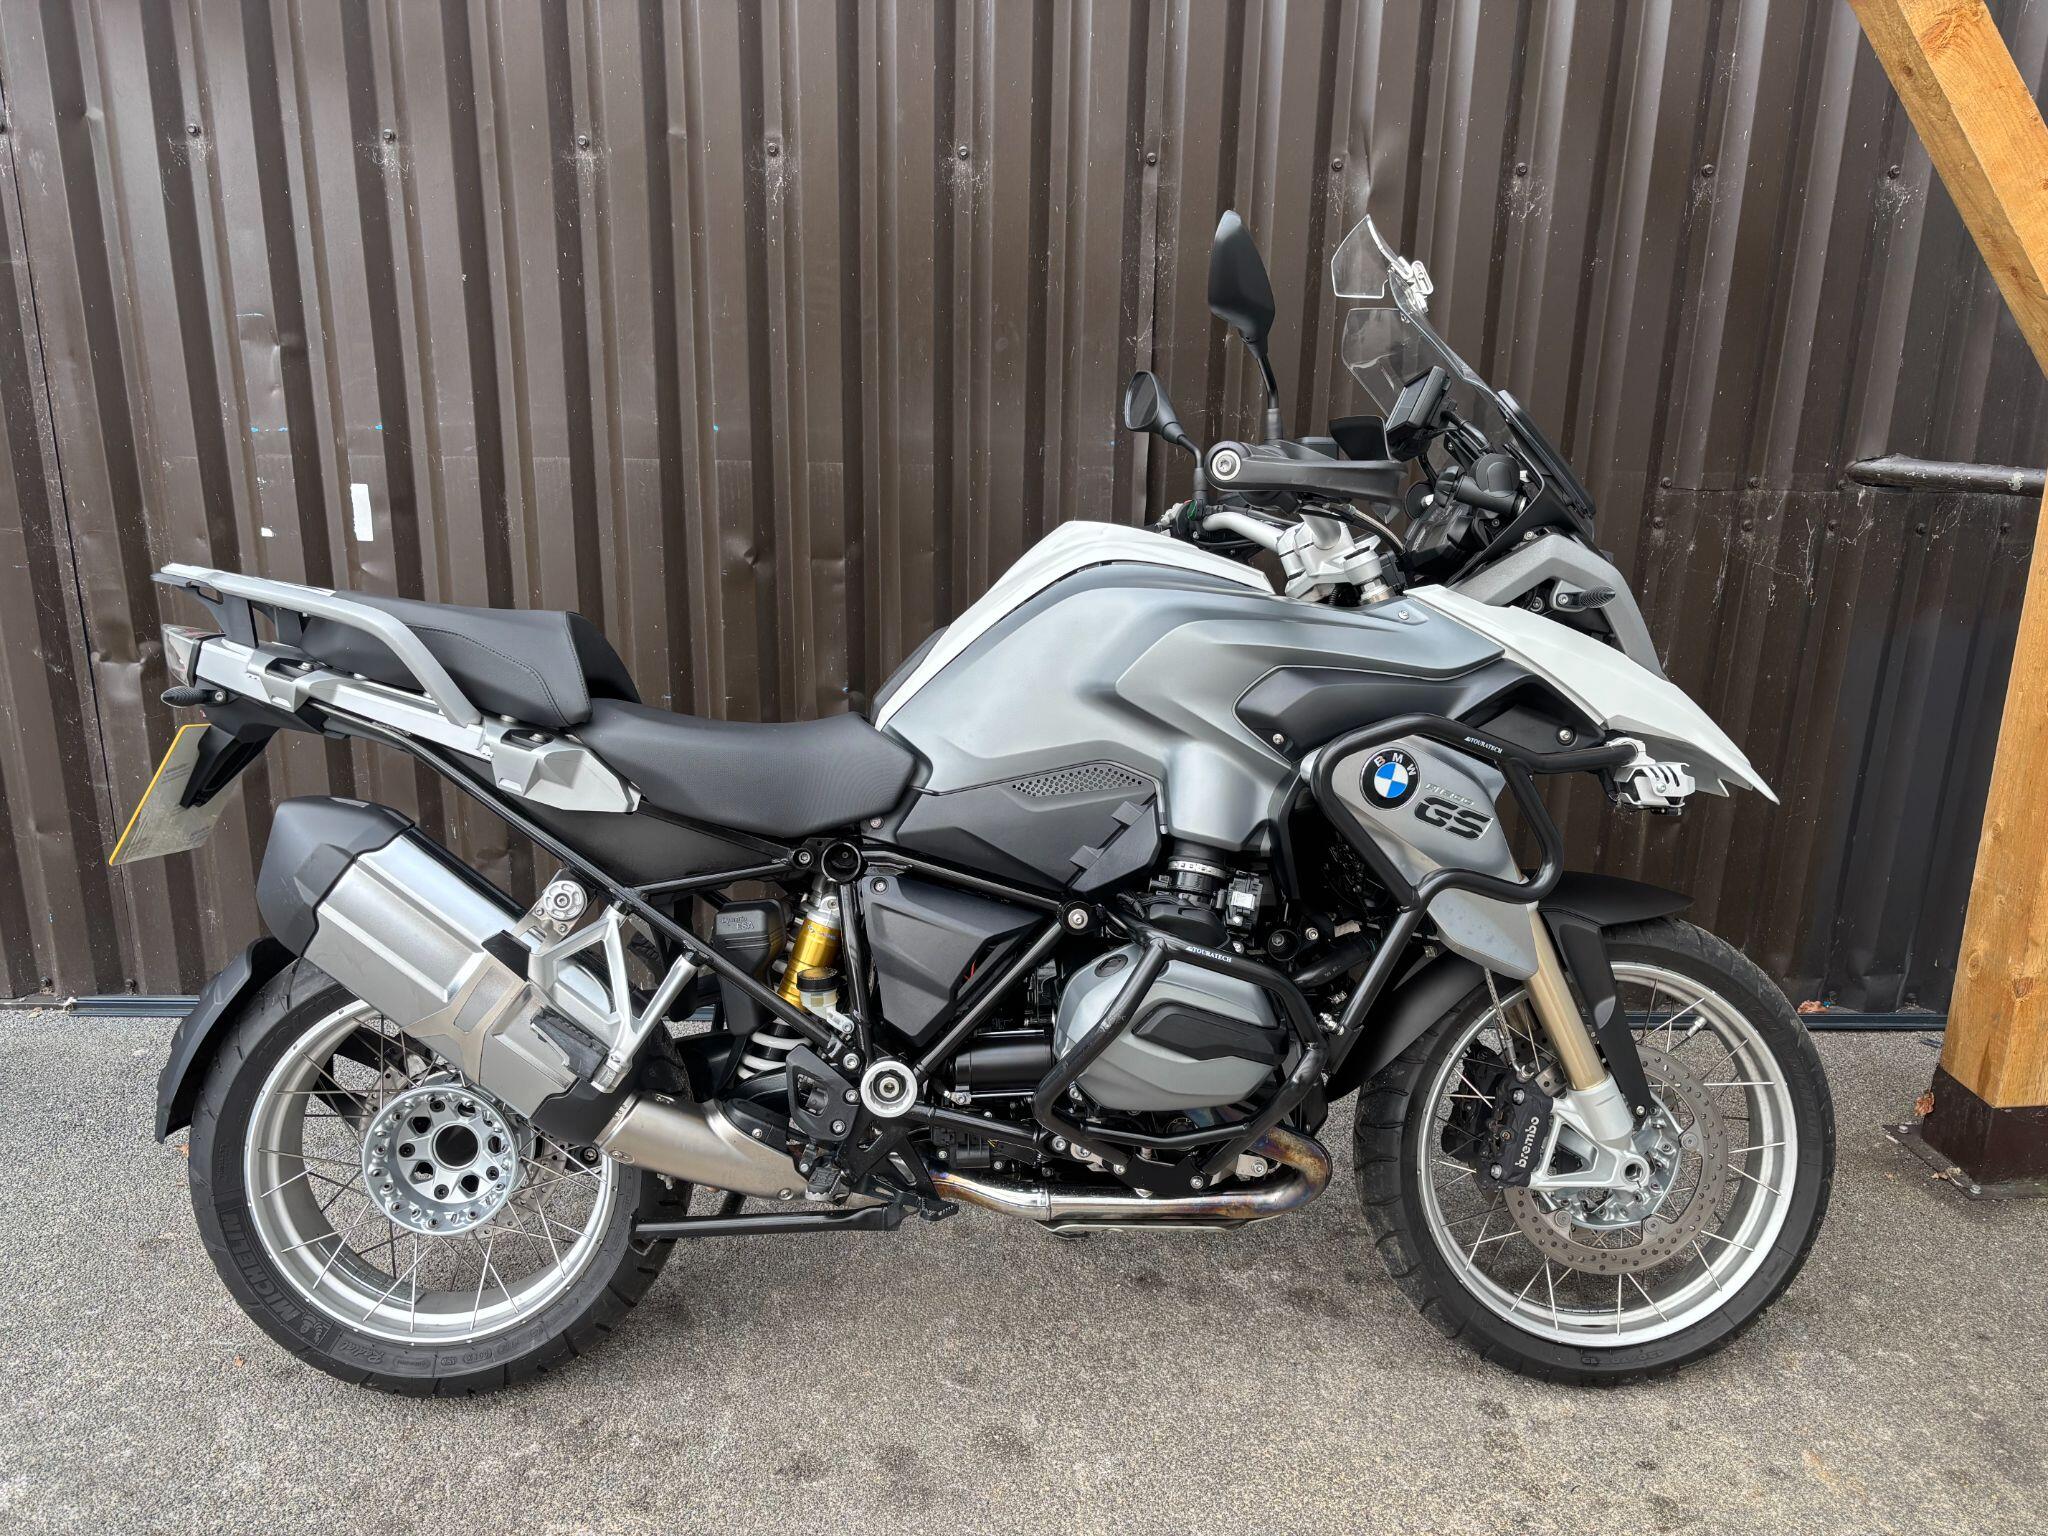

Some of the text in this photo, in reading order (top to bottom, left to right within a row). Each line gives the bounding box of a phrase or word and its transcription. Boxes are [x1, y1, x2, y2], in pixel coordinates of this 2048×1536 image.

[1469, 738, 1503, 754] TOURATECH
[1373, 752, 1417, 776] BMW
[1414, 796, 1492, 840] GS
[1191, 946, 1232, 963] TOURATECH
[1515, 1116, 1540, 1168] brembo
[220, 1213, 300, 1321] MICHELIN
